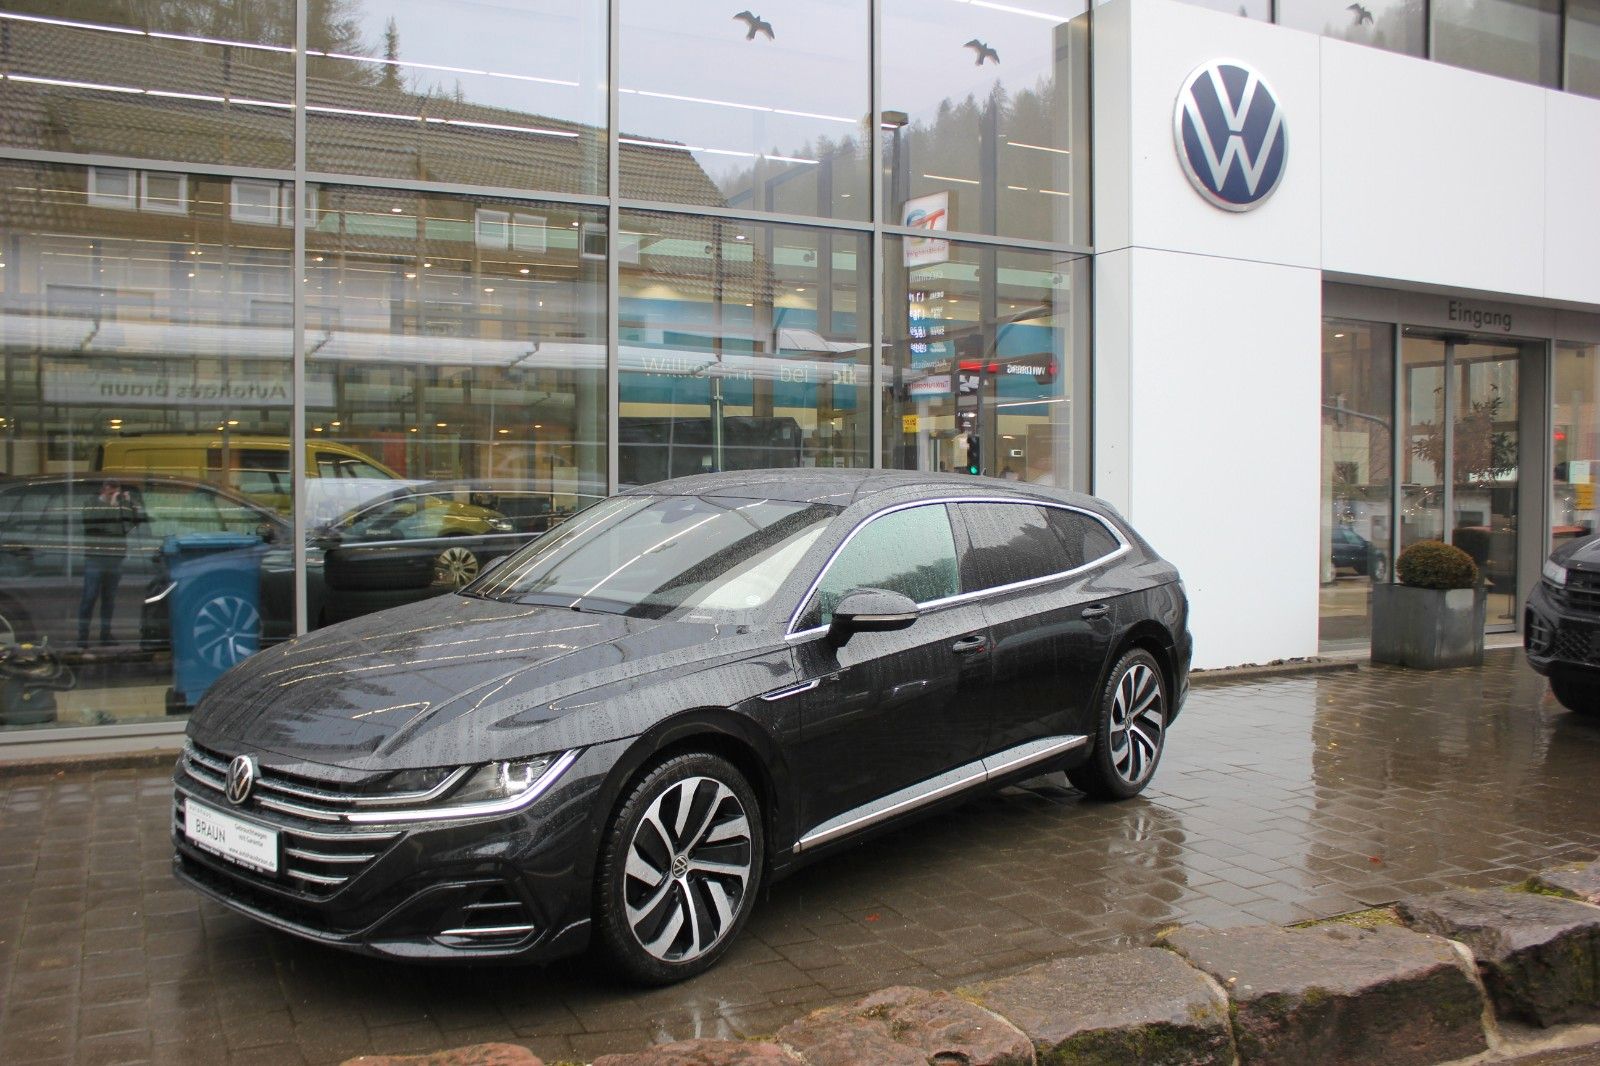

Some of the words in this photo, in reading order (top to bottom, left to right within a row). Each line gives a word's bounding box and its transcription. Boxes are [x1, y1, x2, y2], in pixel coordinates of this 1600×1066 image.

[1174, 59, 1288, 211] VW
[1448, 300, 1513, 331] Eingang
[780, 364, 808, 383] bei
[195, 818, 226, 843] BRAUN
